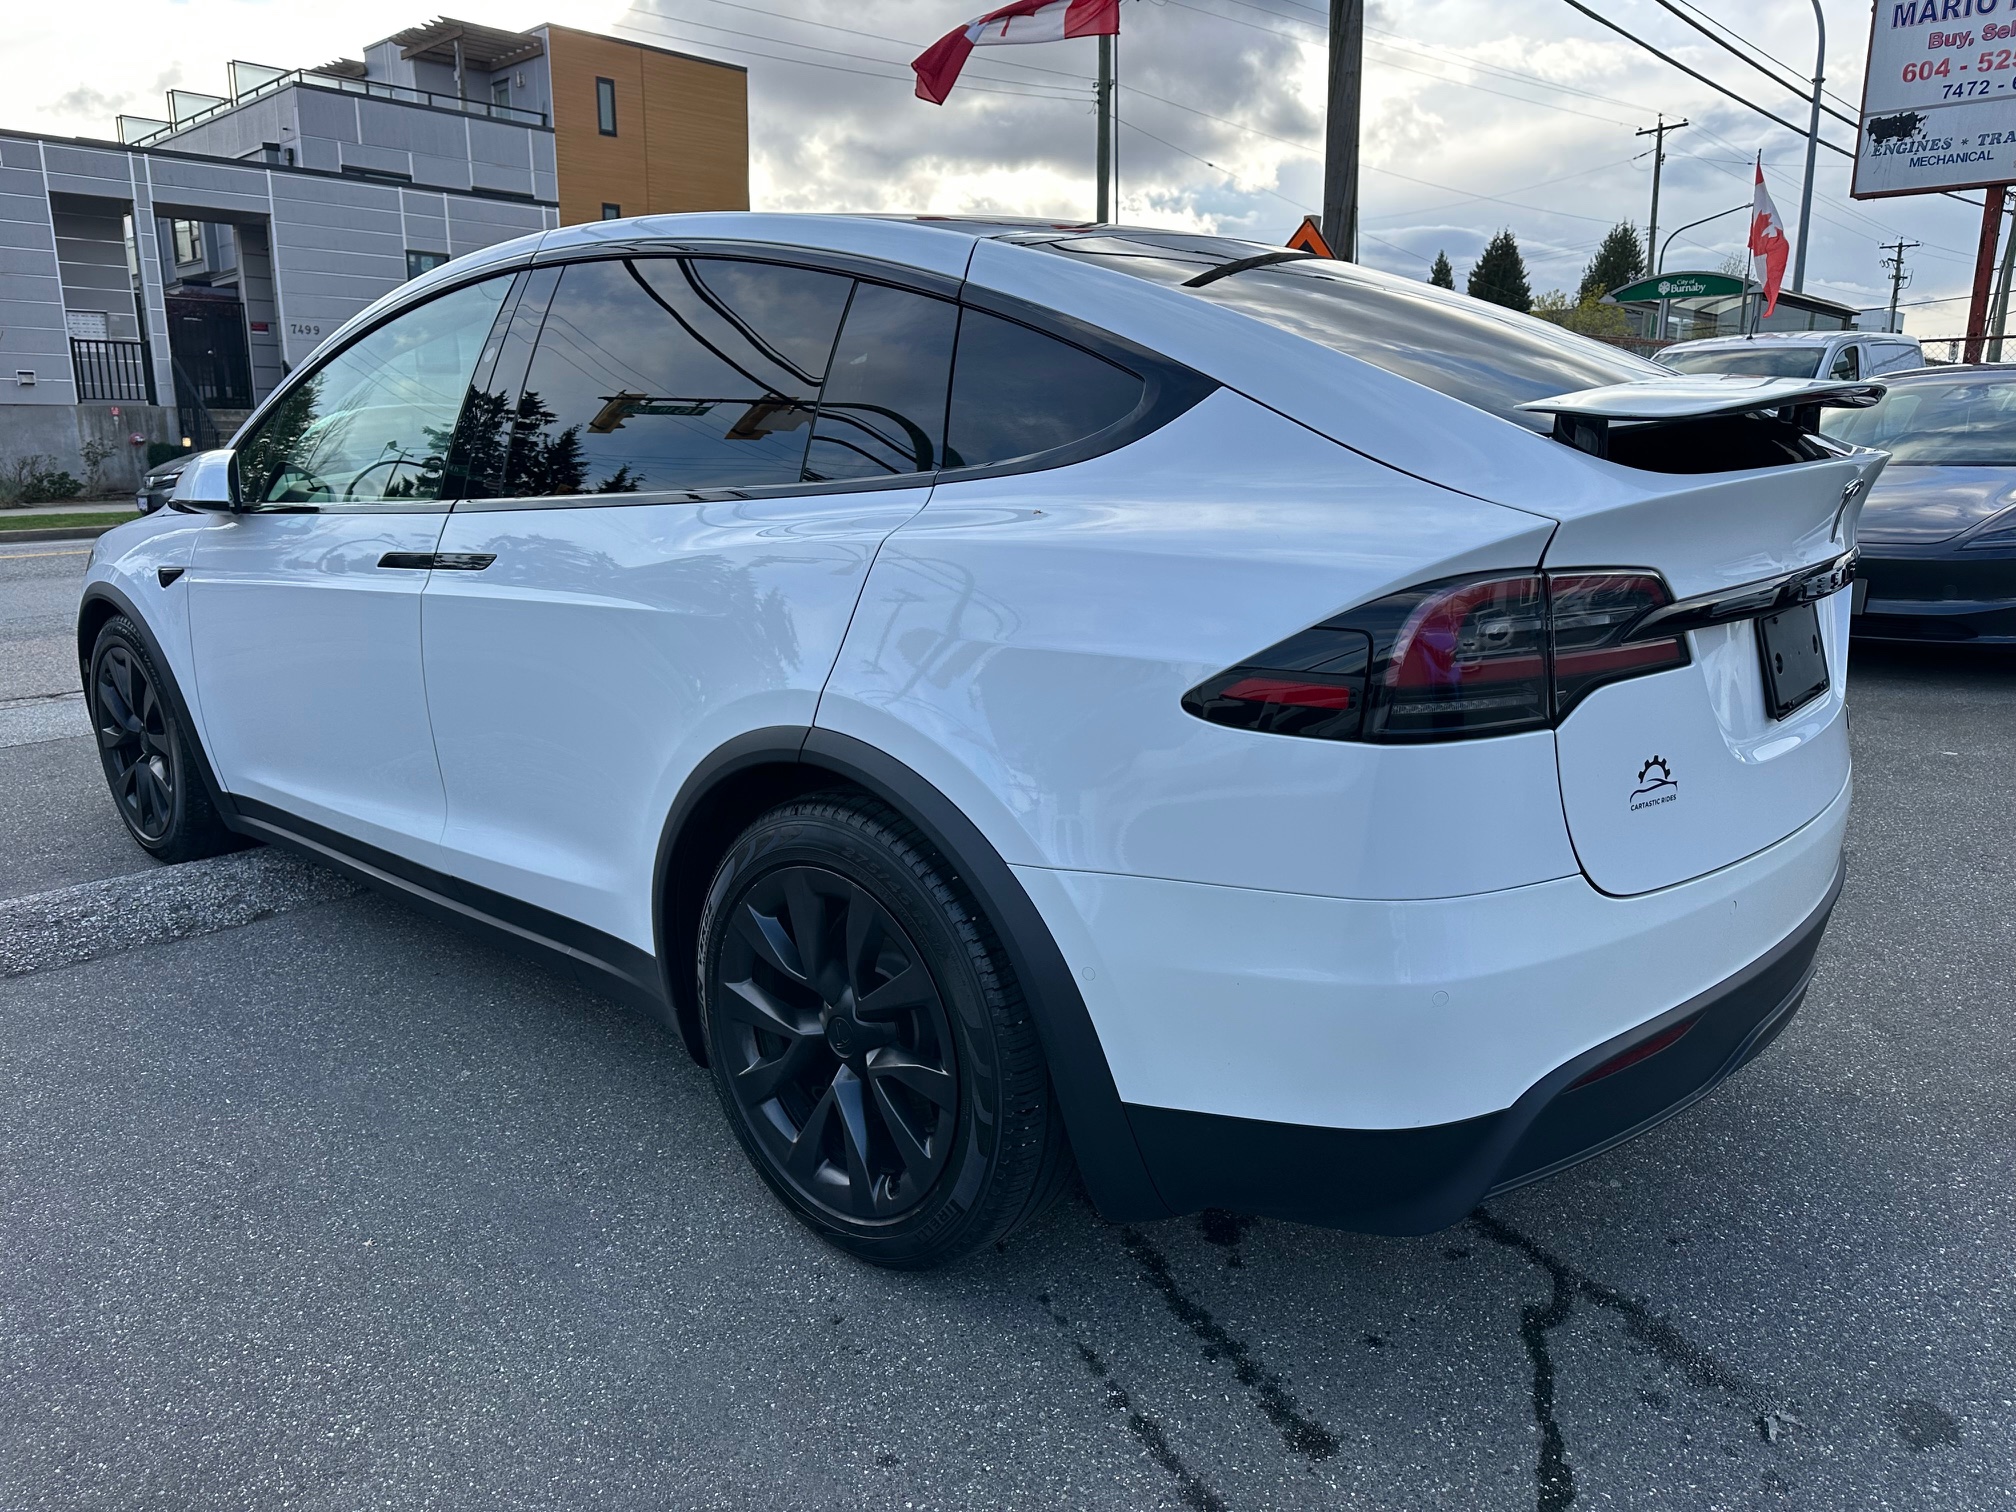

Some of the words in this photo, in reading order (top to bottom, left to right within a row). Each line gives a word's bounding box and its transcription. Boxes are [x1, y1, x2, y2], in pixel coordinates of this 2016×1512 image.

[1892, 0, 1997, 29] MARIO
[1928, 29, 1974, 49] Buy,
[1902, 58, 1950, 83] 604
[1977, 48, 2016, 73] 52
[1942, 80, 1990, 99] 7472
[1871, 137, 1953, 157] ENGINES
[1909, 150, 1994, 168] MECHANICAL
[1671, 283, 1706, 293] Burnaby
[290, 323, 320, 335] 7499
[1630, 798, 1661, 811] CARTASTIC
[1661, 794, 1677, 803] RIDES
